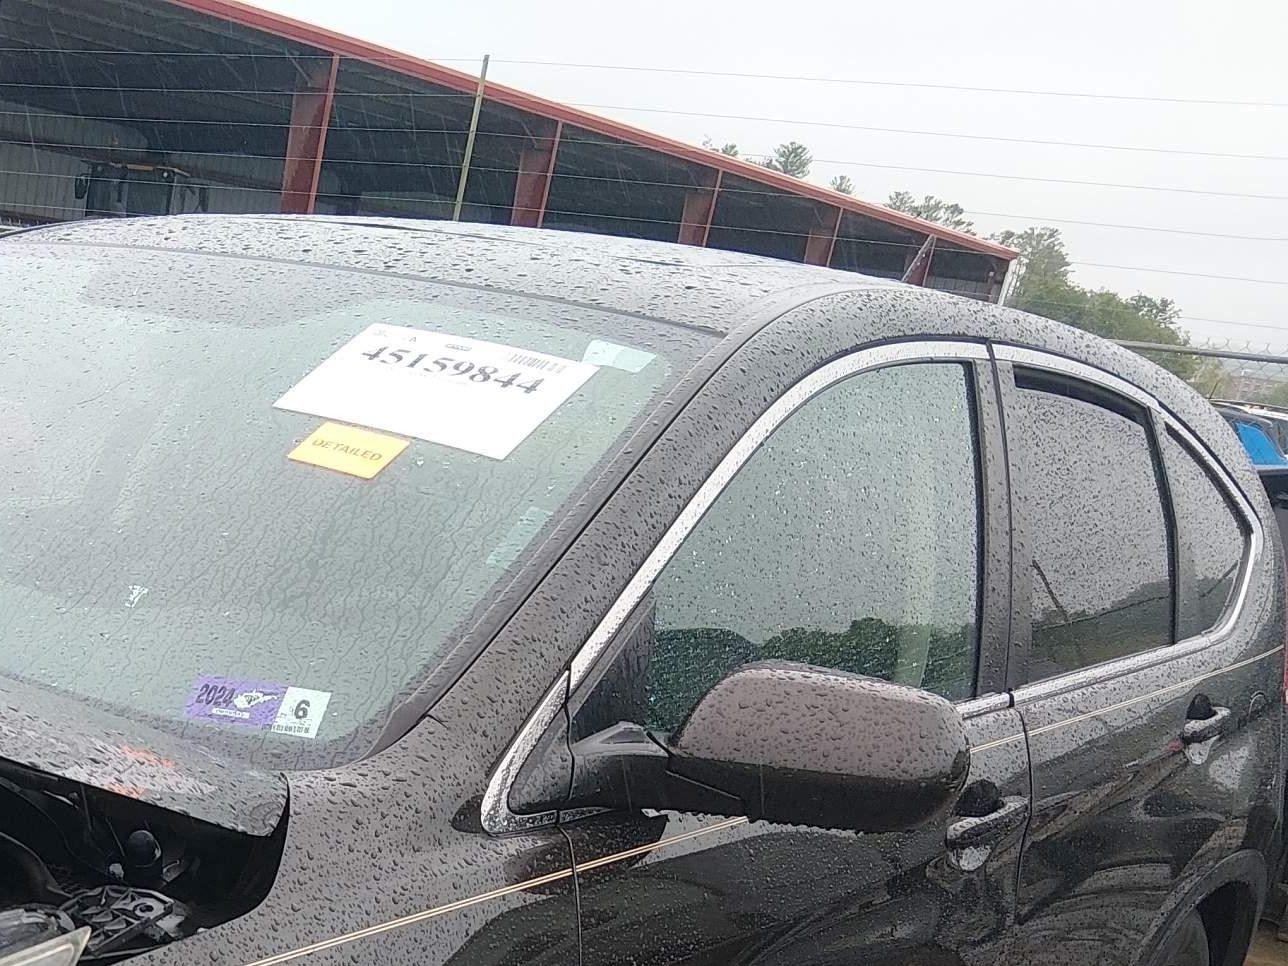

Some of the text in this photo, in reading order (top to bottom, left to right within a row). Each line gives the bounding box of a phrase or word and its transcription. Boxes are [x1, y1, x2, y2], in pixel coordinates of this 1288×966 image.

[361, 345, 545, 395] 45159844
[312, 438, 383, 461] DETAILED
[195, 683, 236, 708] 2024
[294, 698, 311, 720] 6
